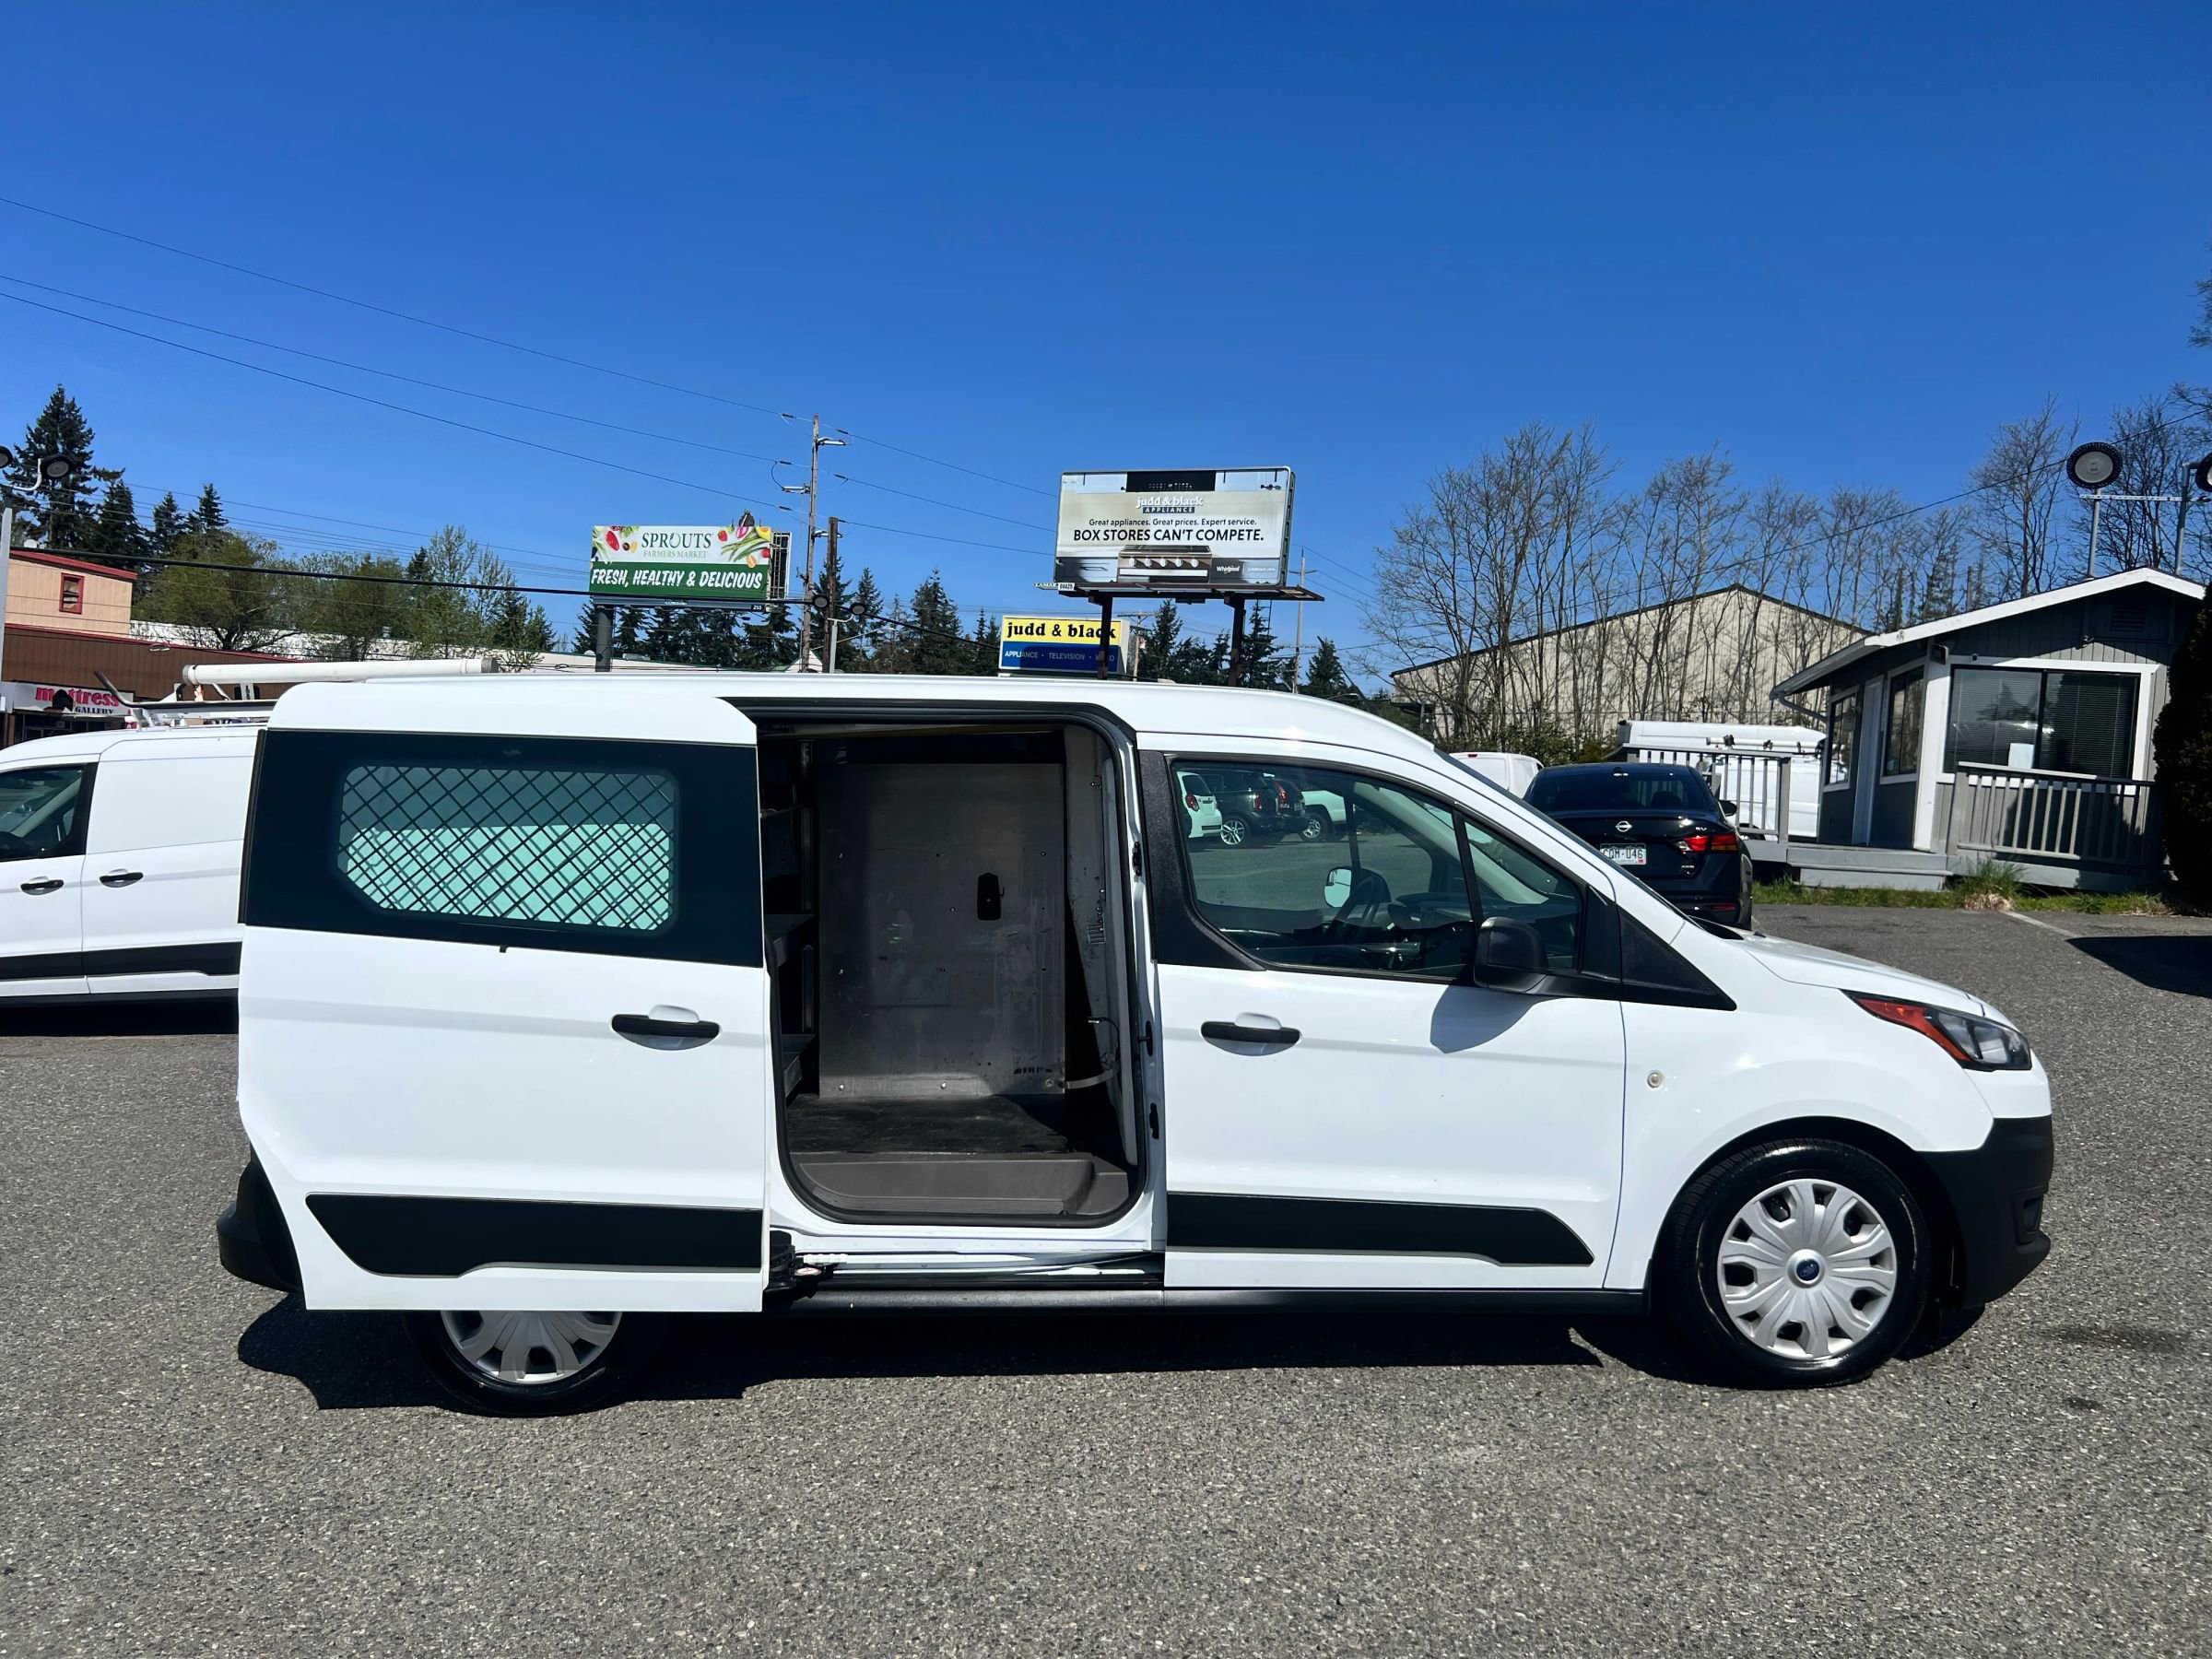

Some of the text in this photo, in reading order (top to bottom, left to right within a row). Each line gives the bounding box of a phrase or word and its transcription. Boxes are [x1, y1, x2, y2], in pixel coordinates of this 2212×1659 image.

[1135, 496, 1204, 509] judd & black
[1088, 518, 1257, 528] Great appliances. Great prices. Expert service.
[641, 532, 712, 549] SPROUTS
[1074, 529, 1265, 541] BOX STORES CAN'T COMPETE.
[643, 550, 708, 559] FARMERS MARKET
[1217, 565, 1241, 574] Whirlpool
[591, 568, 763, 589] FRESH, HEALTHY & DELICIOUS
[1007, 622, 1045, 638] judd
[1052, 624, 1062, 637] &
[1005, 650, 1039, 659] APPLIANCE
[1049, 652, 1086, 661] TELEVISION
[36, 688, 119, 707] mttress
